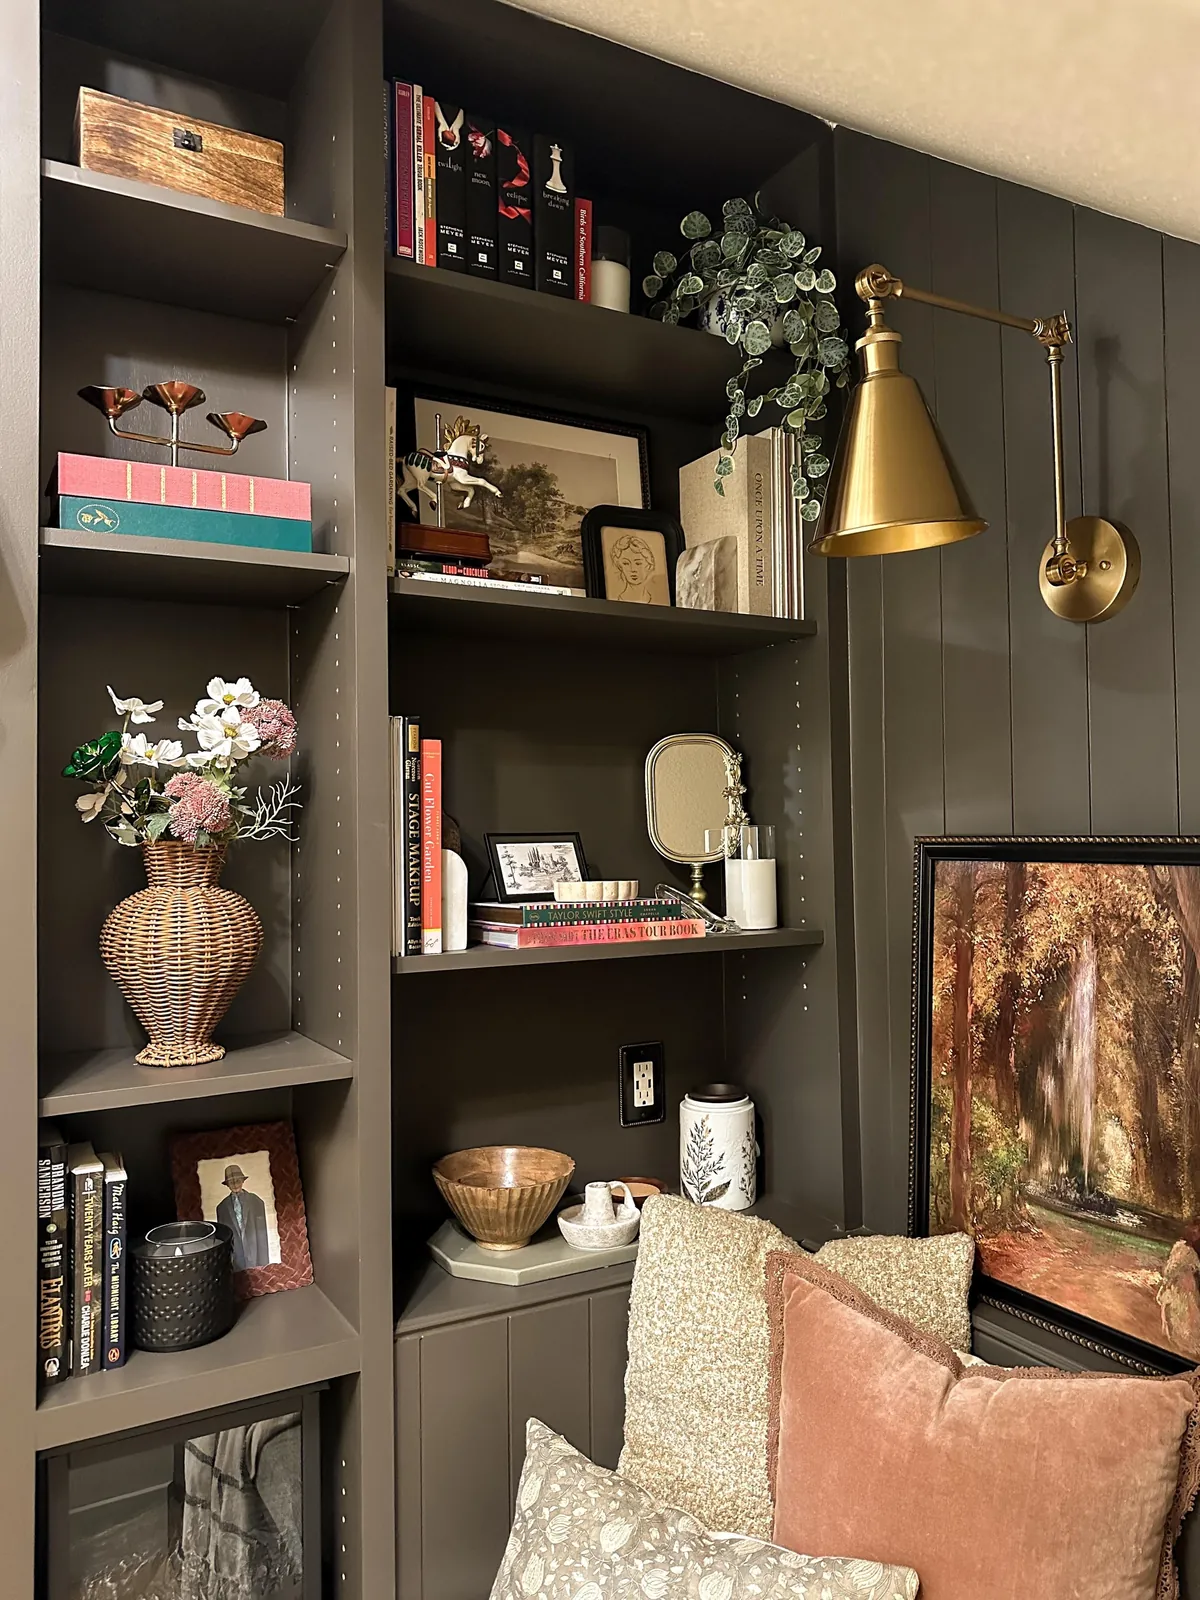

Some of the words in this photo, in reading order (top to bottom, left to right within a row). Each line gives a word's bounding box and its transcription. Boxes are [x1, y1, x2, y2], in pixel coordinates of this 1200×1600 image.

[438, 157, 462, 172] twilight
[472, 178, 491, 188] moon
[506, 192, 528, 205] eclipse
[542, 191, 570, 207] breaking
[548, 200, 564, 210] dawn
[440, 230, 464, 238] MEYER
[471, 240, 494, 248] MEYER
[580, 227, 586, 235] of
[508, 247, 529, 255] MEYER
[546, 256, 568, 265] MEYER
[578, 267, 586, 300] California
[754, 472, 763, 506] ONCE
[755, 510, 764, 543] UPON
[756, 546, 764, 554] A
[440, 578, 488, 588] MAGNOLIA
[442, 564, 457, 574] BLOOD
[463, 567, 489, 578] CHOCOLATE
[756, 556, 764, 586] TIME
[424, 773, 435, 793] Cut
[408, 793, 420, 838] STAGE
[424, 797, 435, 837] Flower
[409, 842, 420, 906] MAKEUP
[424, 840, 435, 882] Garden
[548, 911, 580, 920] TAYLOR
[582, 910, 607, 919] SWIFT
[610, 908, 632, 918] STYLE
[581, 928, 605, 940] THE
[607, 927, 636, 940] ERAS
[638, 925, 667, 938] TOUR
[669, 923, 698, 935] BOOK
[39, 1160, 52, 1218] SANDERSON
[52, 1163, 65, 1212] BRANDON
[112, 1184, 124, 1210] Matt
[84, 1196, 94, 1232] TWENTY
[107, 1212, 124, 1235] Haig
[84, 1233, 94, 1260] YEARS
[84, 1261, 94, 1288] LATER
[111, 1262, 120, 1274] The
[111, 1275, 120, 1310] MIDNIGHT
[40, 1275, 64, 1349] ELANTRIS
[81, 1305, 91, 1338] CHARLIE
[110, 1312, 119, 1343] LIBRARY
[81, 1338, 90, 1370] DONLEA
